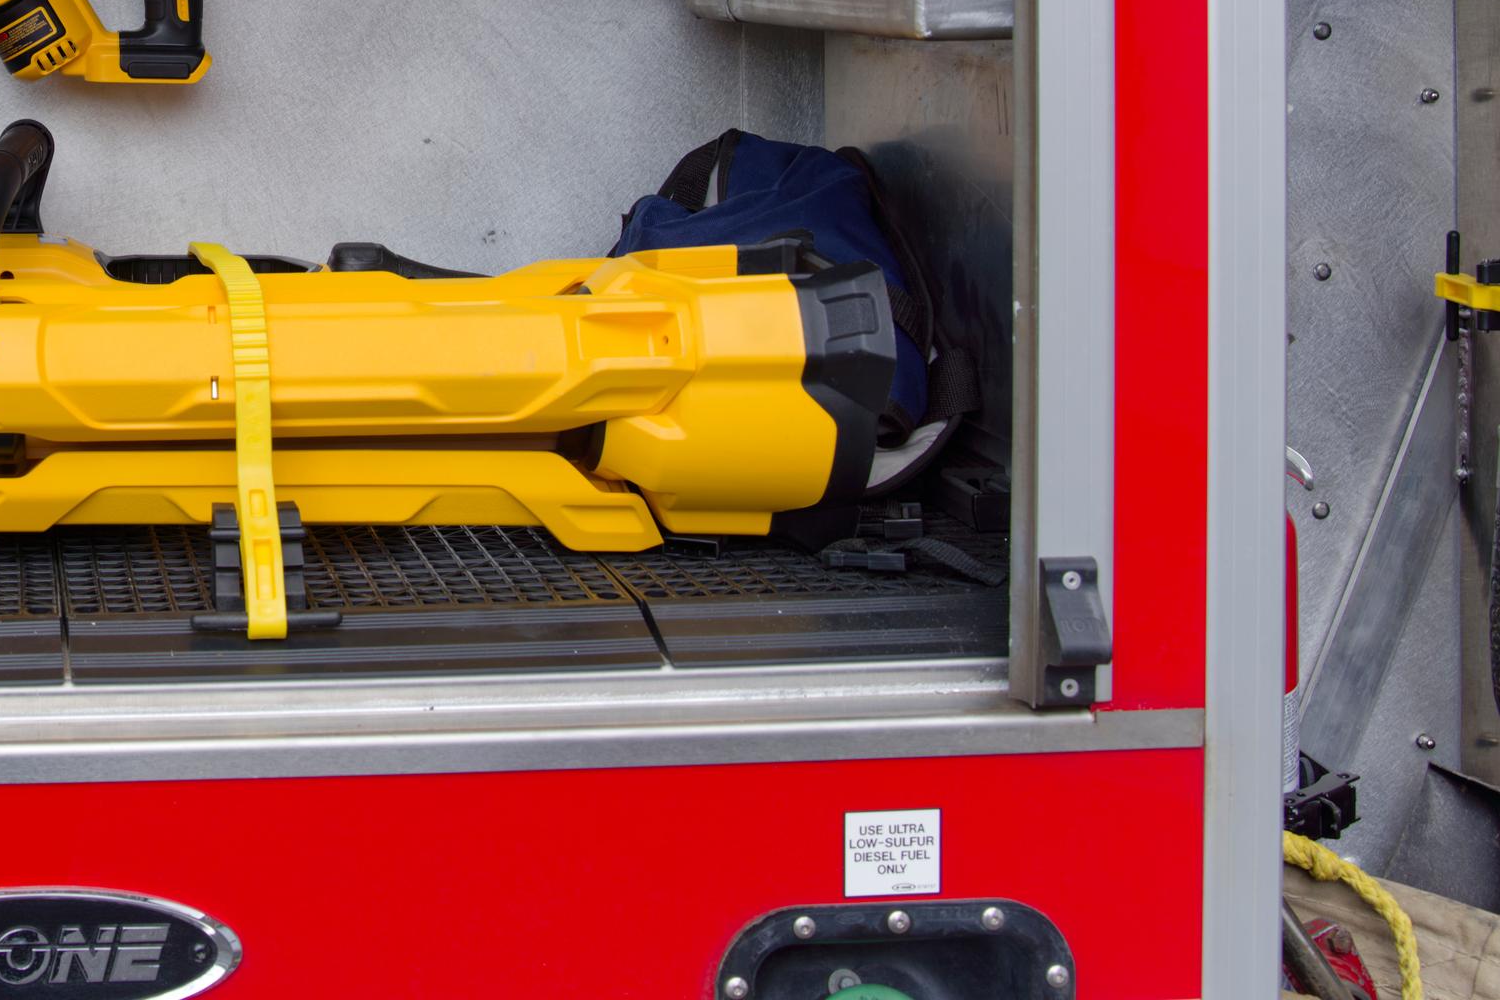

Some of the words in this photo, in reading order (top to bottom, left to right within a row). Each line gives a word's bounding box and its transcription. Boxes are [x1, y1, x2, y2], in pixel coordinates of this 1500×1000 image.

[859, 825, 883, 836] USE
[888, 823, 925, 835] ULTRA
[849, 836, 934, 849] LOW-SULFUR
[854, 851, 896, 863] DIESEL
[901, 849, 930, 861] FUEL
[877, 864, 907, 875] ONLY
